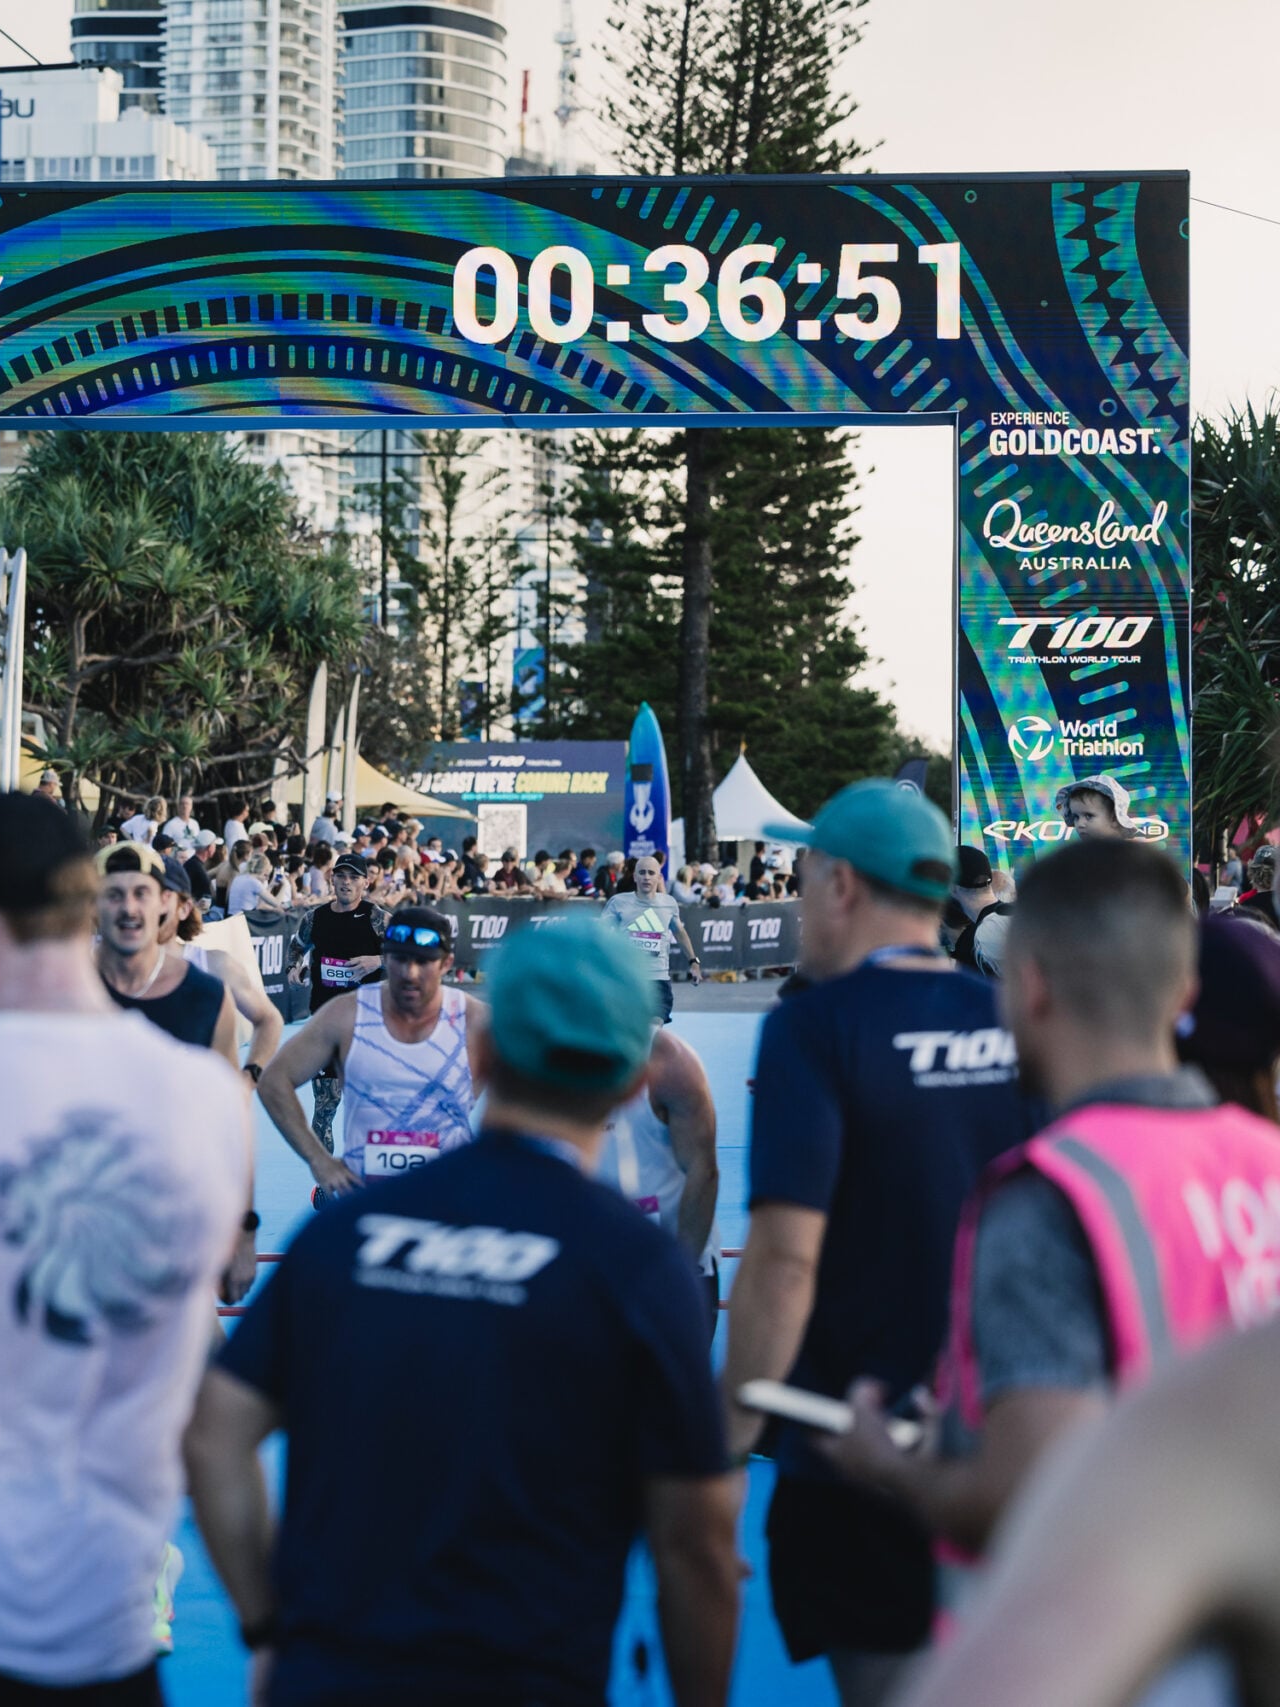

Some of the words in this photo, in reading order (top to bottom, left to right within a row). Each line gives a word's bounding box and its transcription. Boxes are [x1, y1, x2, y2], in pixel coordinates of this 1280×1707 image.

[452, 241, 961, 345] 00:36:51
[990, 411, 1070, 426] EXPERIENCE
[983, 499, 1168, 553] Queensland
[1019, 556, 1132, 571] AUSTRALIA
[997, 616, 1154, 649] T100
[1008, 656, 1067, 664] TRIATHLON
[1069, 656, 1109, 664] WORLD
[1111, 656, 1141, 664] TOUR
[1059, 719, 1117, 738] World
[1059, 738, 1144, 757] Triathlon
[469, 914, 509, 939] T100
[700, 919, 734, 943] T100
[747, 917, 782, 941] T100
